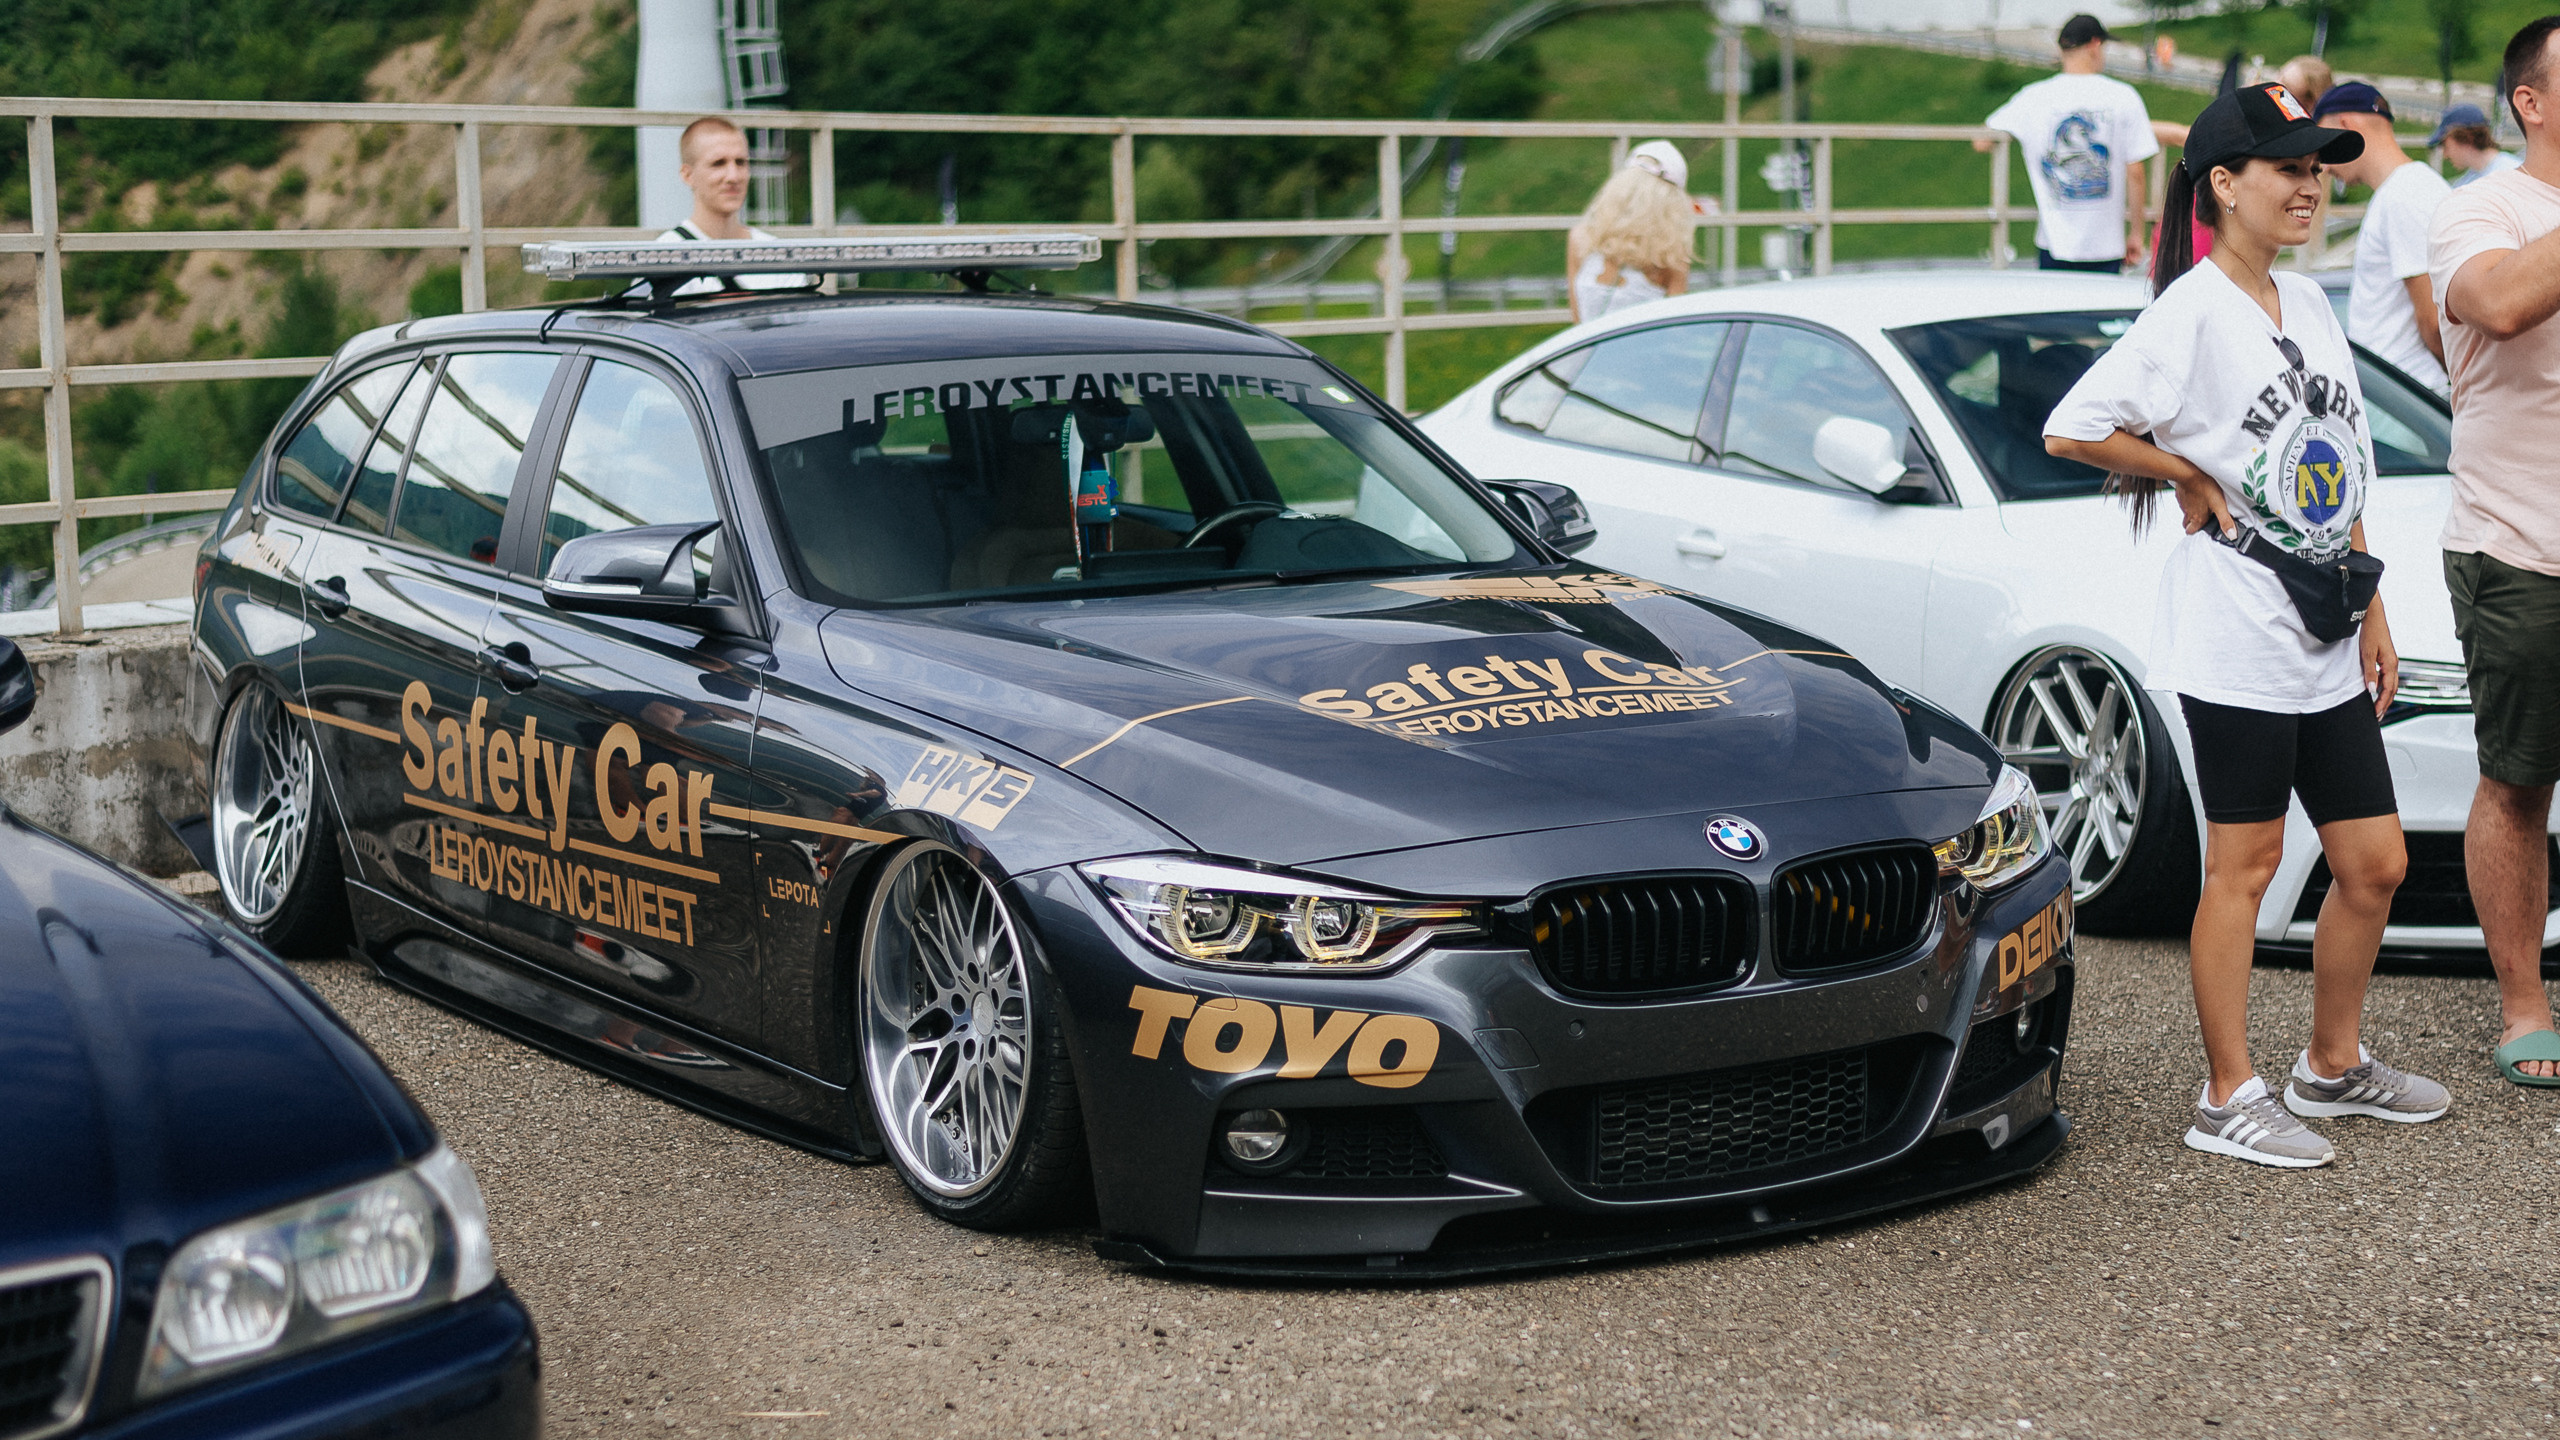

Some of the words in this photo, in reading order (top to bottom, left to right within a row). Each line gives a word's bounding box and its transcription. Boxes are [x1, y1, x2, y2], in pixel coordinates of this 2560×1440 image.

[843, 372, 1313, 425] LEROYSTANCEMEET
[2302, 374, 2361, 436] ORK
[2296, 461, 2345, 508] NY
[1299, 653, 1574, 719] Safety
[1581, 649, 1724, 687] Car
[1375, 689, 1734, 737] LEROYSTANCEMEET
[401, 679, 576, 852] Safety
[595, 722, 714, 858] Car
[906, 748, 1032, 812] HKS
[429, 824, 698, 948] LEROYSTANCEMEET
[768, 876, 820, 909] LEPOTA
[1128, 984, 1440, 1089] TOYO
